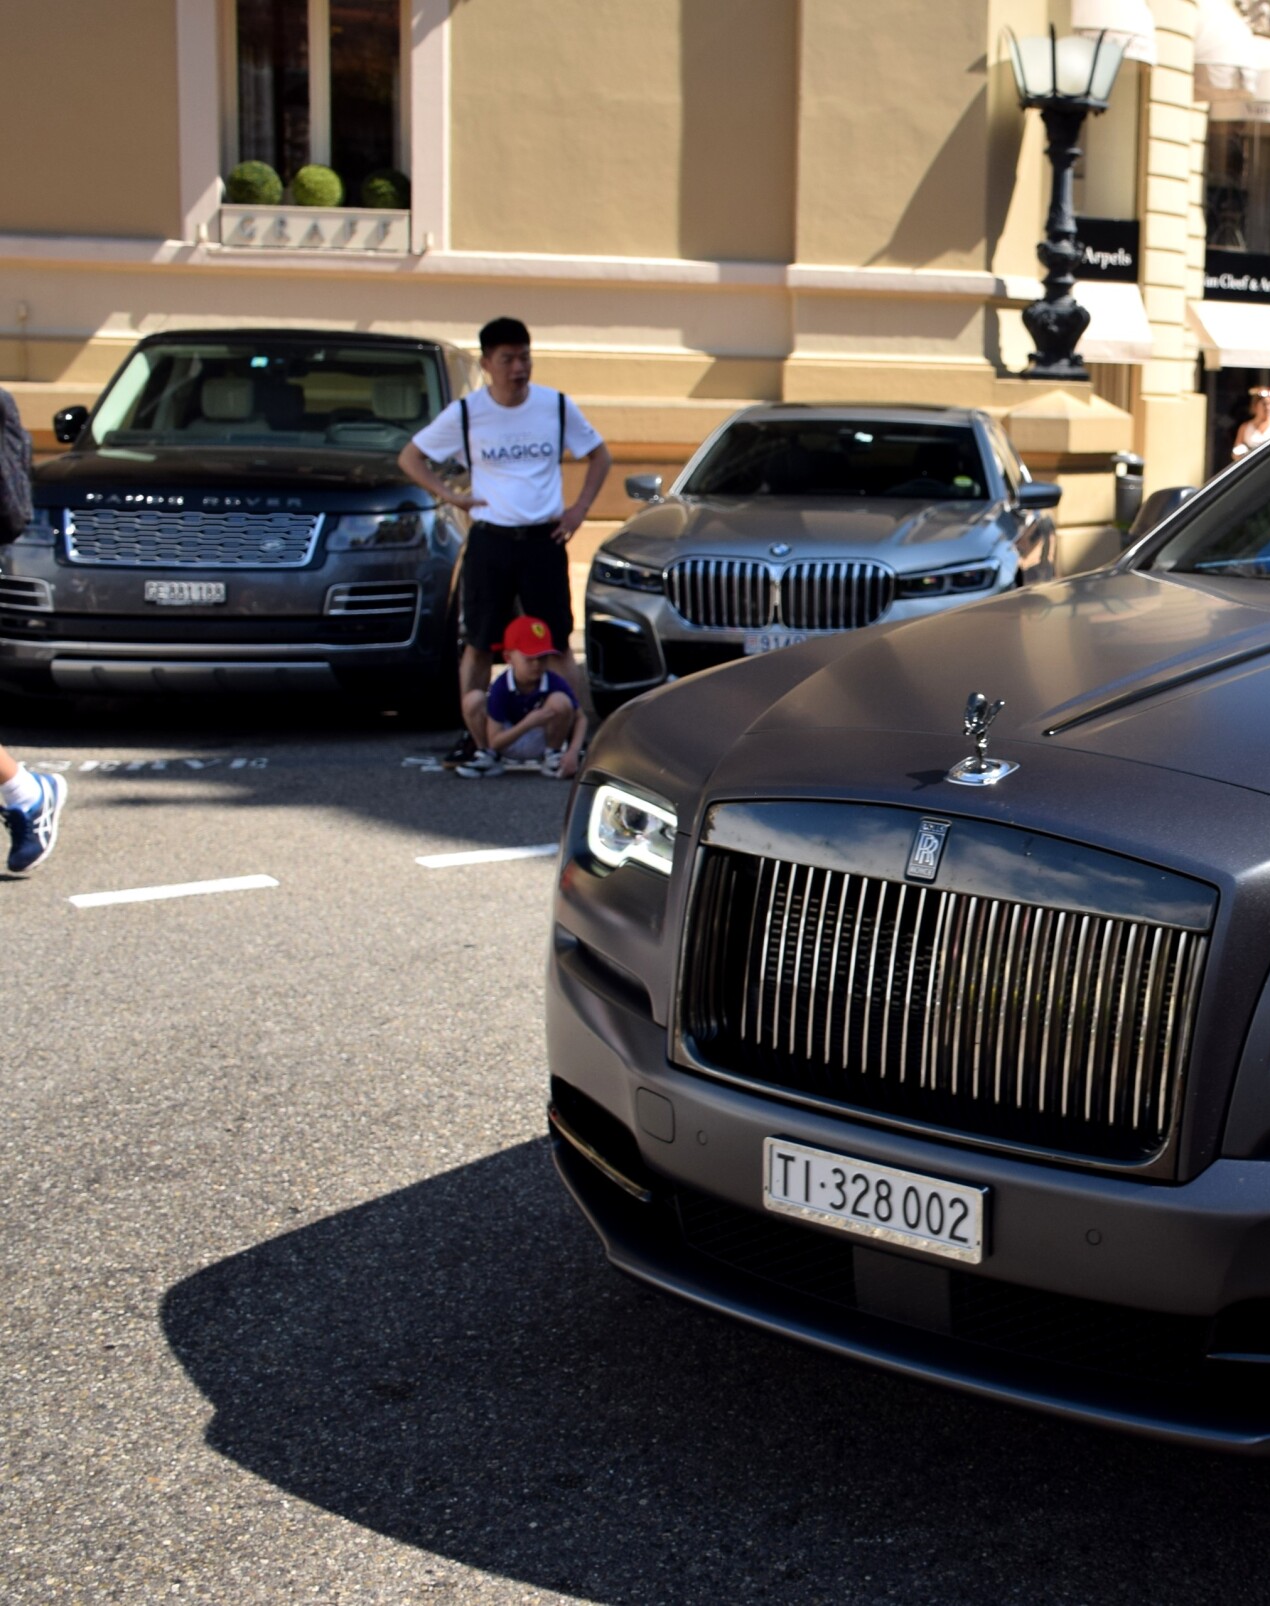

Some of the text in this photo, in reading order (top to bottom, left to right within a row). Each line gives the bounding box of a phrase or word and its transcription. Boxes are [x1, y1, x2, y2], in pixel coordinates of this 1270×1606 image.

[1083, 247, 1132, 269] Arpels
[1219, 272, 1250, 291] Cleef
[481, 442, 553, 459] MAGICO
